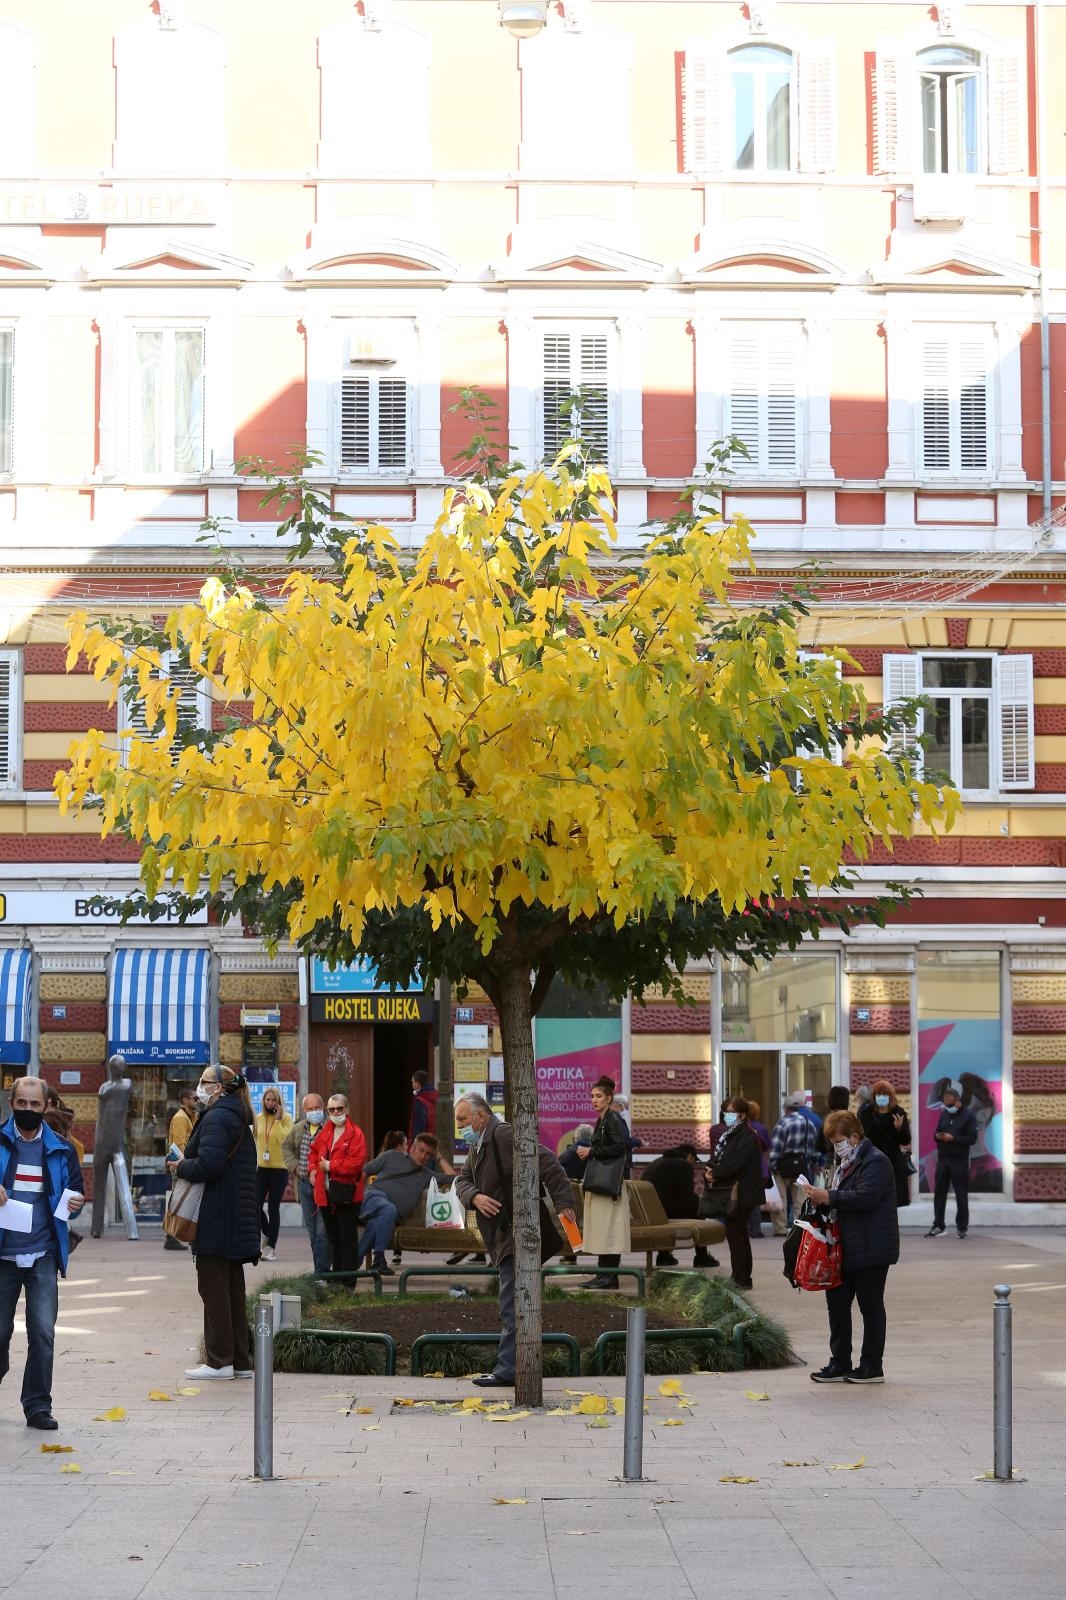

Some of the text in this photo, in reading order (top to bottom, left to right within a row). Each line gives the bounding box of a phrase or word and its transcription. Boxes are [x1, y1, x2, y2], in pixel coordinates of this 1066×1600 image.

[103, 192, 209, 219] RIJEKA
[325, 998, 421, 1020] HOSTEL RIJEKA
[459, 1008, 470, 1017] 32
[116, 1047, 145, 1055] KNJIŽARA
[537, 1067, 585, 1080] OPTIKA
[537, 1079, 574, 1091] NAJBRŽI
[537, 1092, 551, 1101] NA
[537, 1103, 574, 1112] FIKSNOJ
